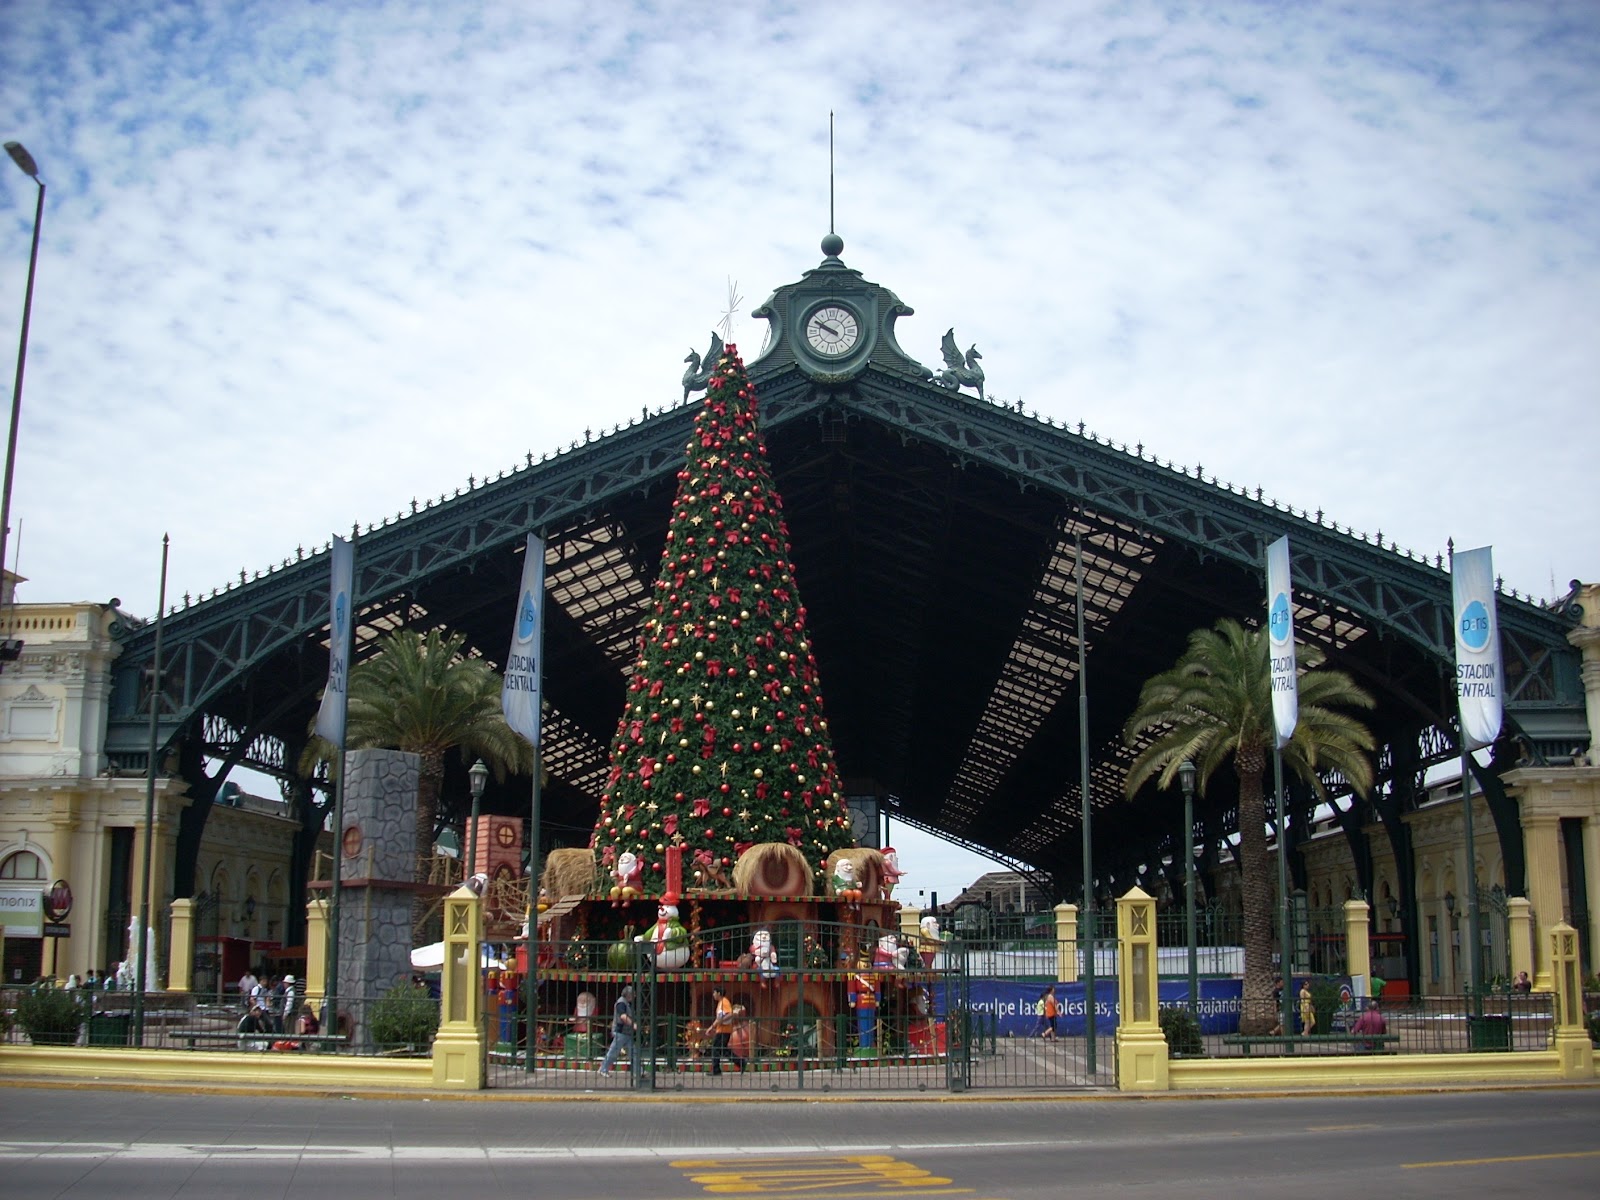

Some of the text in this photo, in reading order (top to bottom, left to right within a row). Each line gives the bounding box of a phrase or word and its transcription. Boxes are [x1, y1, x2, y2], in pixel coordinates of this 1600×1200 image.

[1462, 617, 1488, 634] paris
[1457, 663, 1495, 679] STACION
[1457, 682, 1496, 697] ENTRAL
[1055, 998, 1112, 1018] olestas,
